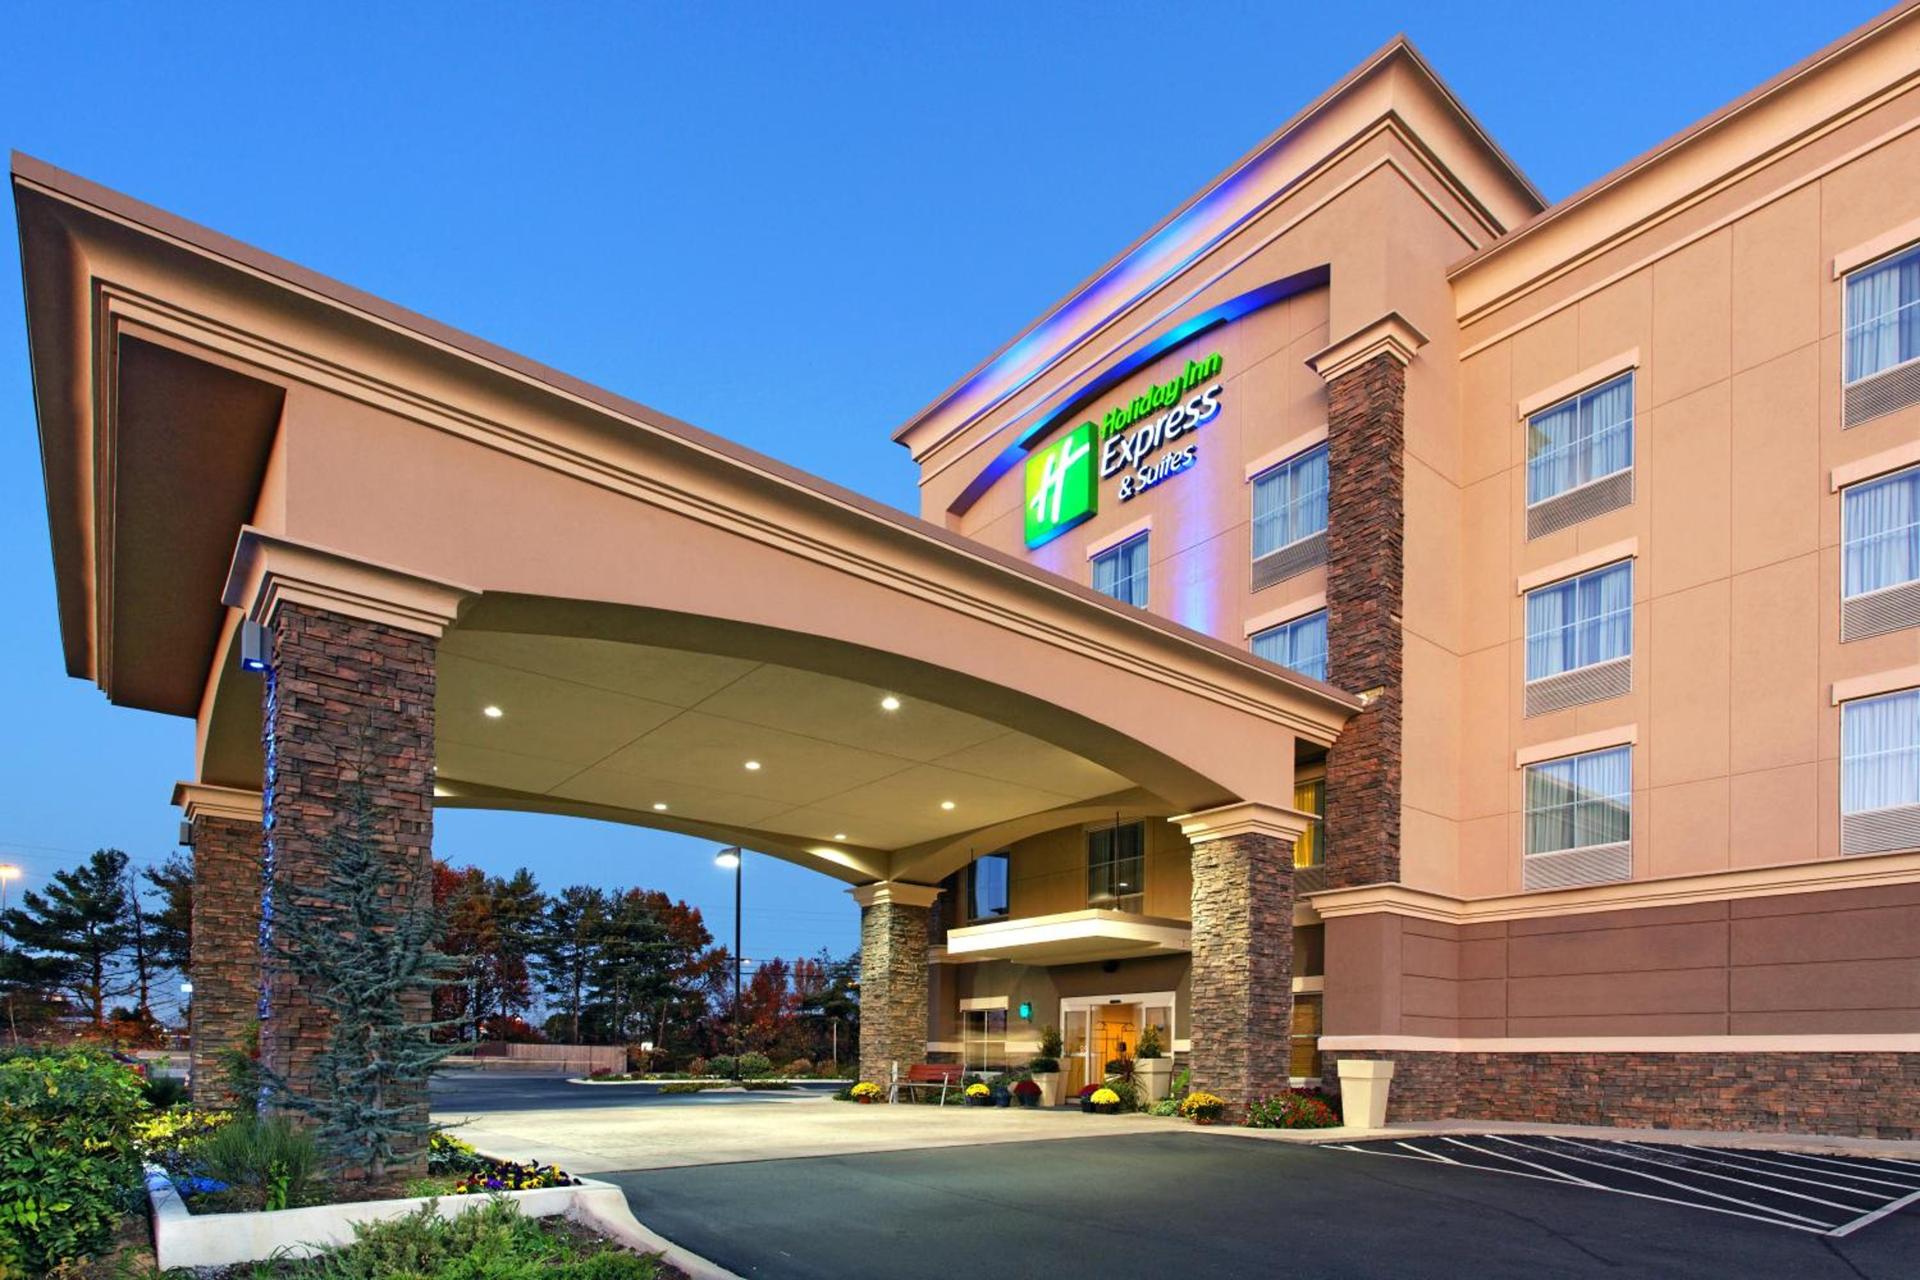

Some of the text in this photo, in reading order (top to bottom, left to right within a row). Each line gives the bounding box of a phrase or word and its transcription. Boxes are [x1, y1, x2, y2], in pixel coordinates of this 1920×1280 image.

[1101, 384, 1223, 479] Express
[1102, 352, 1223, 439] Holiday Inn
[1119, 445, 1198, 502] & Suites
